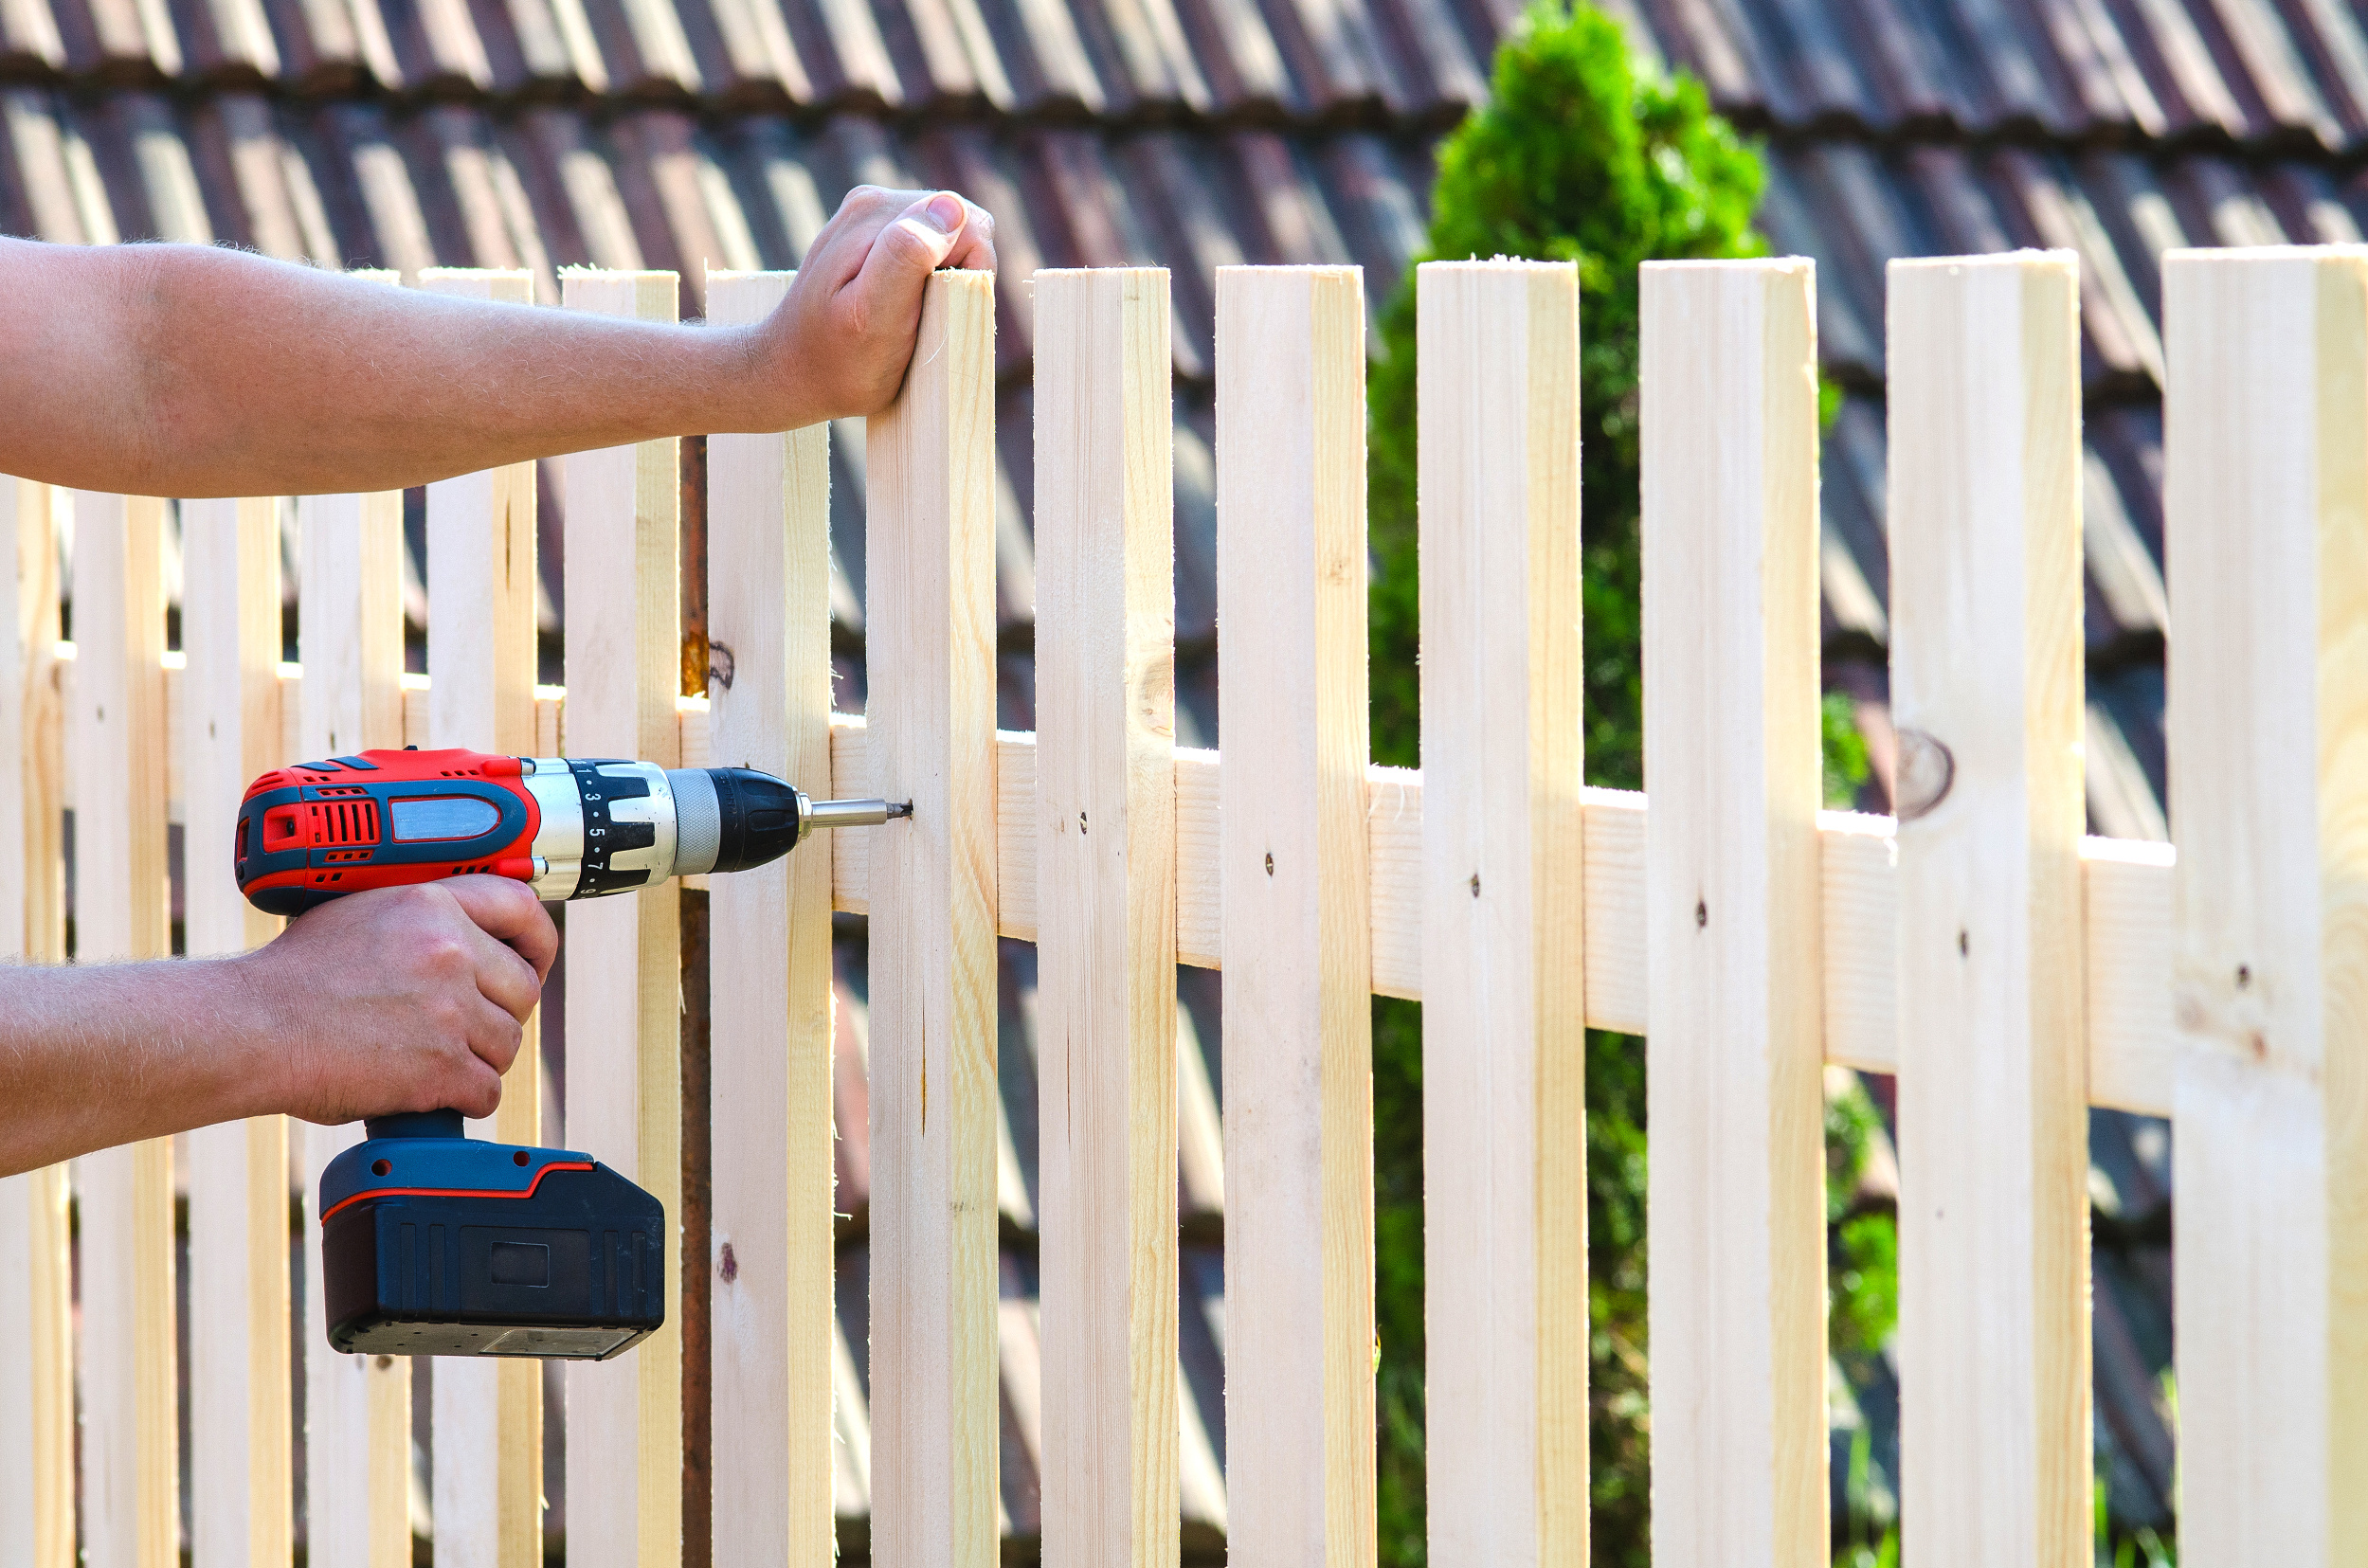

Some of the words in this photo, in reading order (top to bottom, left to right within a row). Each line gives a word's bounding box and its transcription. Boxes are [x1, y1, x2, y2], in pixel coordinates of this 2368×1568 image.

[585, 793, 602, 802] 3
[589, 828, 606, 837] 5
[587, 862, 604, 871] 7
